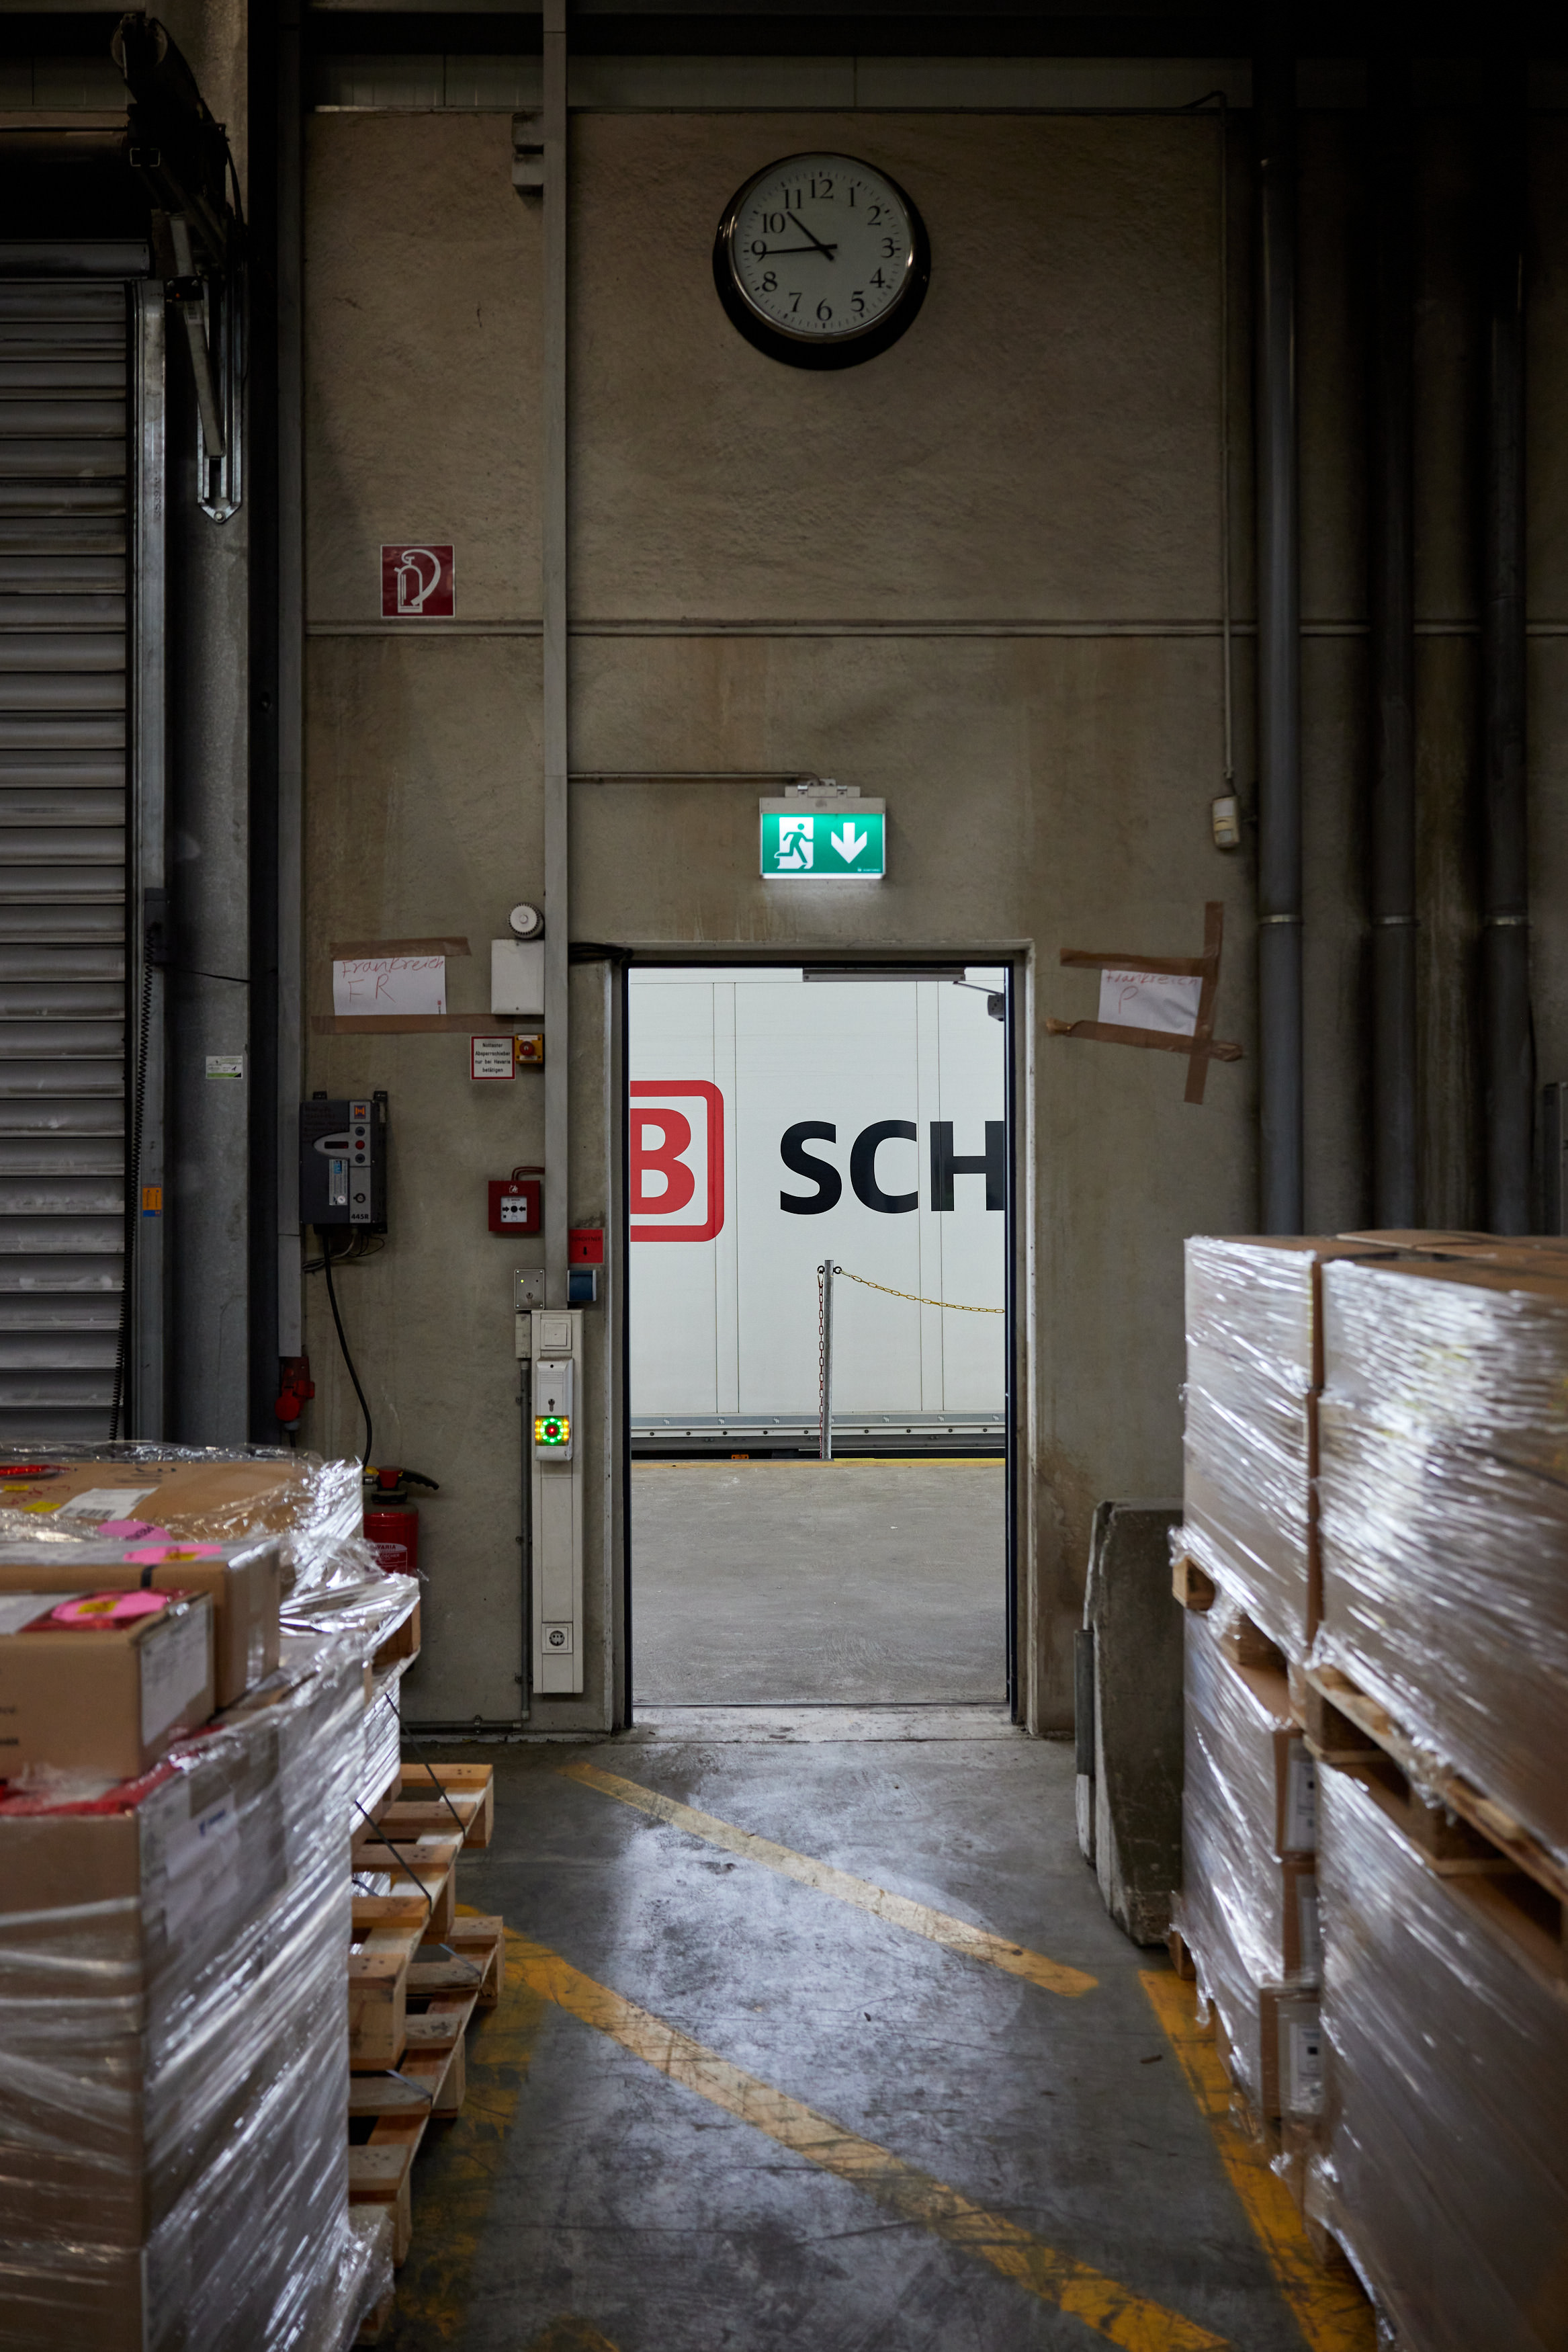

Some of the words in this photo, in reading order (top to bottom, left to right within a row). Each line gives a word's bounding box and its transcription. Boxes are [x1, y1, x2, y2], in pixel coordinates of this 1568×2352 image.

[783, 189, 802, 210] 11
[808, 179, 834, 200] 12
[848, 187, 856, 207] 1
[761, 212, 785, 234] 10
[867, 206, 881, 226] 2
[751, 240, 767, 263] 9
[881, 237, 895, 258] 3
[762, 271, 778, 292] 8
[869, 267, 885, 288] 4
[789, 292, 803, 312] 7
[816, 298, 833, 322] 6
[851, 290, 865, 312] 5
[341, 956, 445, 979] Frankreich
[1118, 985, 1139, 1015] P
[779, 1119, 1005, 1216] SCH
